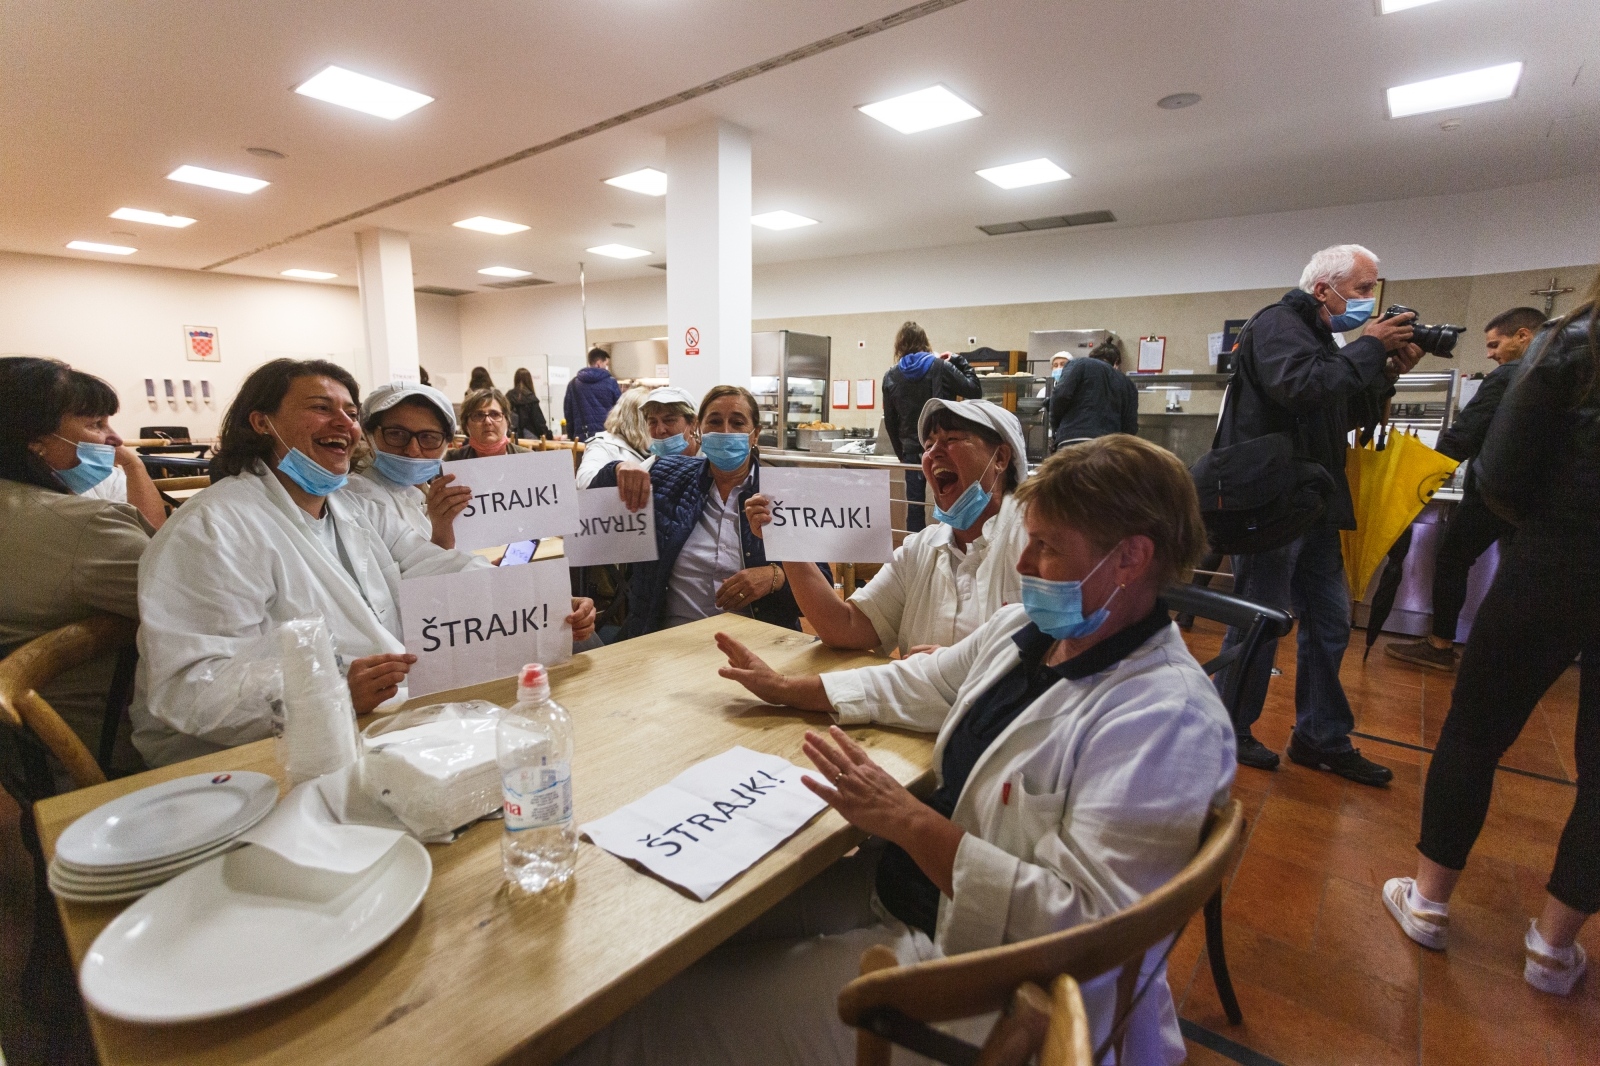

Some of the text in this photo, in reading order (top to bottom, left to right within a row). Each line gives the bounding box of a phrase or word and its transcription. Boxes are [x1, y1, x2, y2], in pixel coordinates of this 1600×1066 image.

[574, 513, 647, 537] ŠTRAJK
[772, 500, 871, 529] ŠTRAJK!
[422, 603, 548, 652] ŠTRAJK!
[637, 770, 785, 857] ŠTRAJK!
